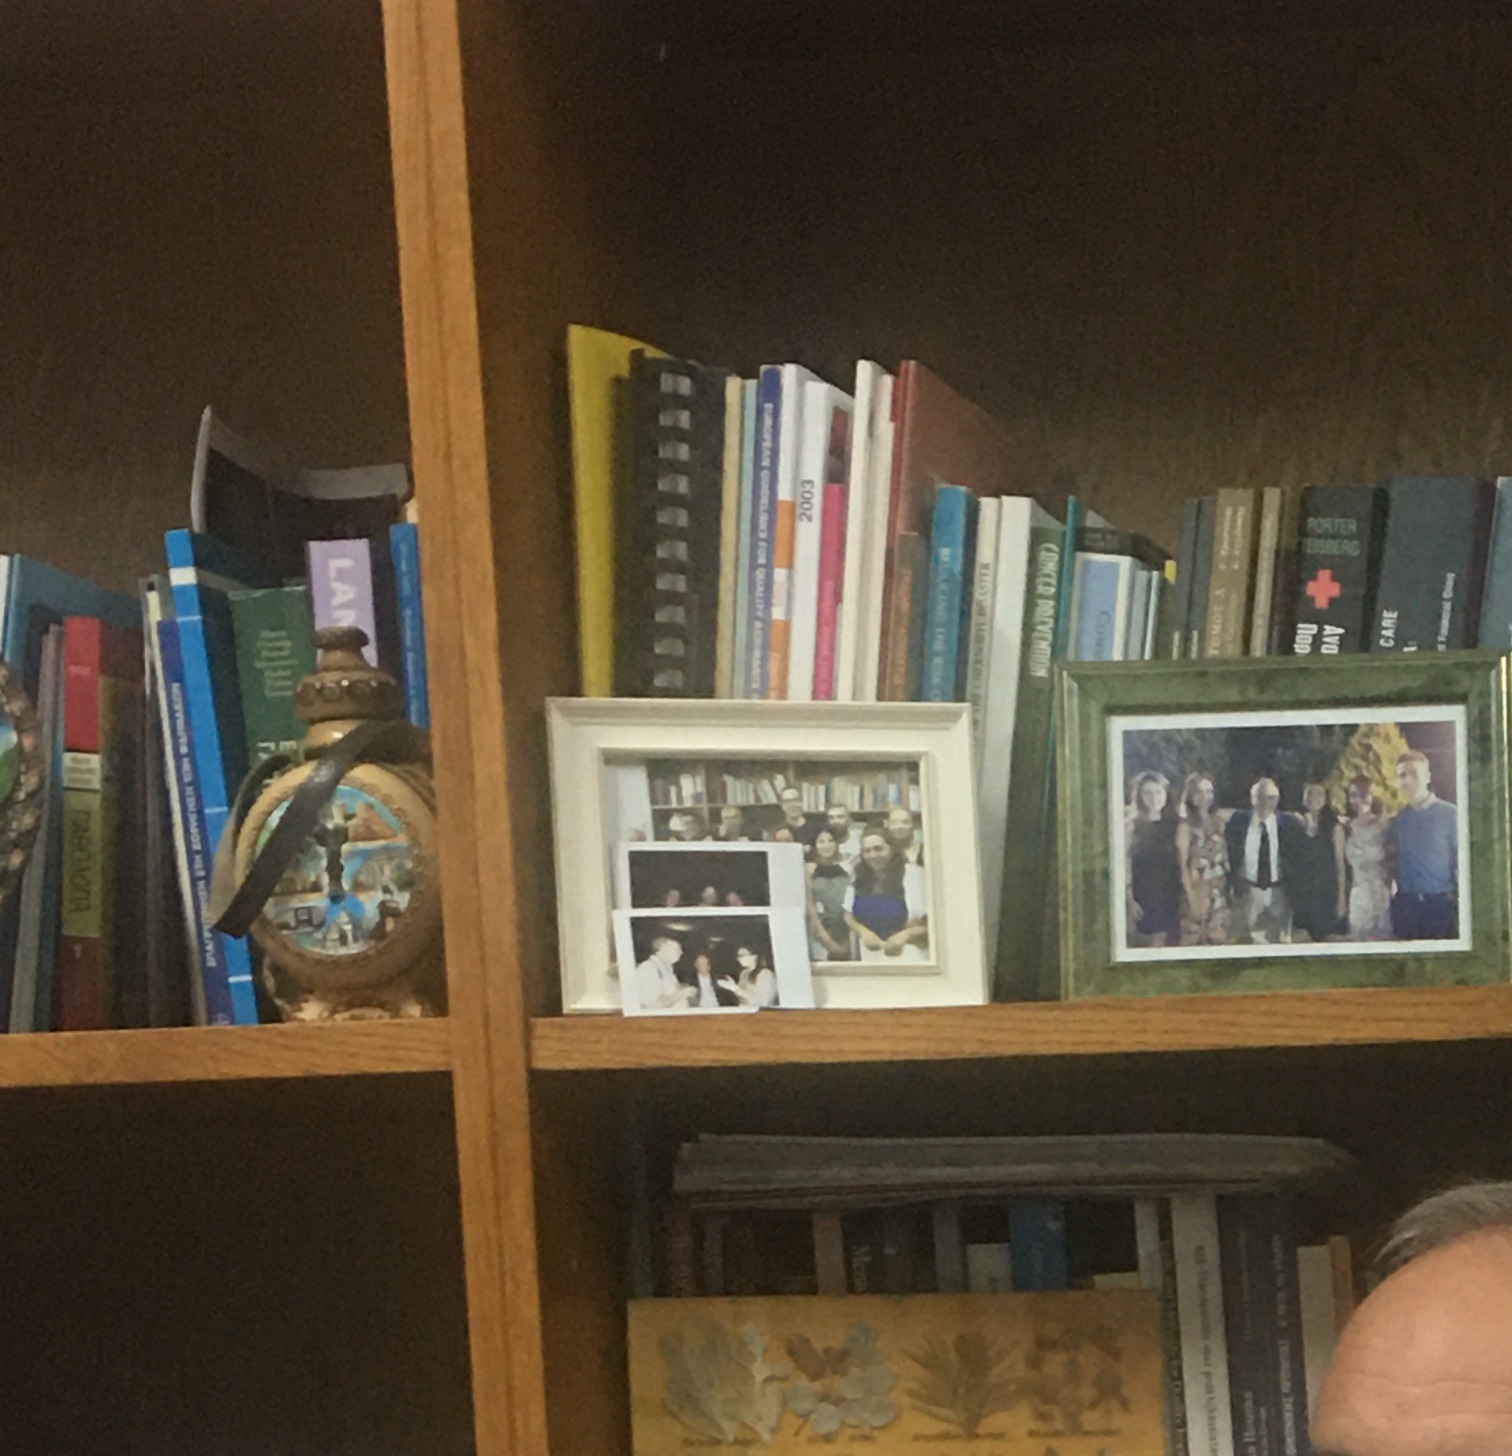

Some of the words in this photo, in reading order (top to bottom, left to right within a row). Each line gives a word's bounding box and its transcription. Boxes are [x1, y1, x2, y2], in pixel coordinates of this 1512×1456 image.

[761, 403, 774, 467] EUROPEAN
[798, 478, 815, 523] 2003
[1306, 517, 1357, 534] PORTER
[756, 541, 767, 565] FOR
[1036, 542, 1060, 596] CANCER
[755, 567, 767, 619] QUALITY
[1029, 599, 1057, 678] PREVENTION
[1379, 609, 1398, 648] CARE
